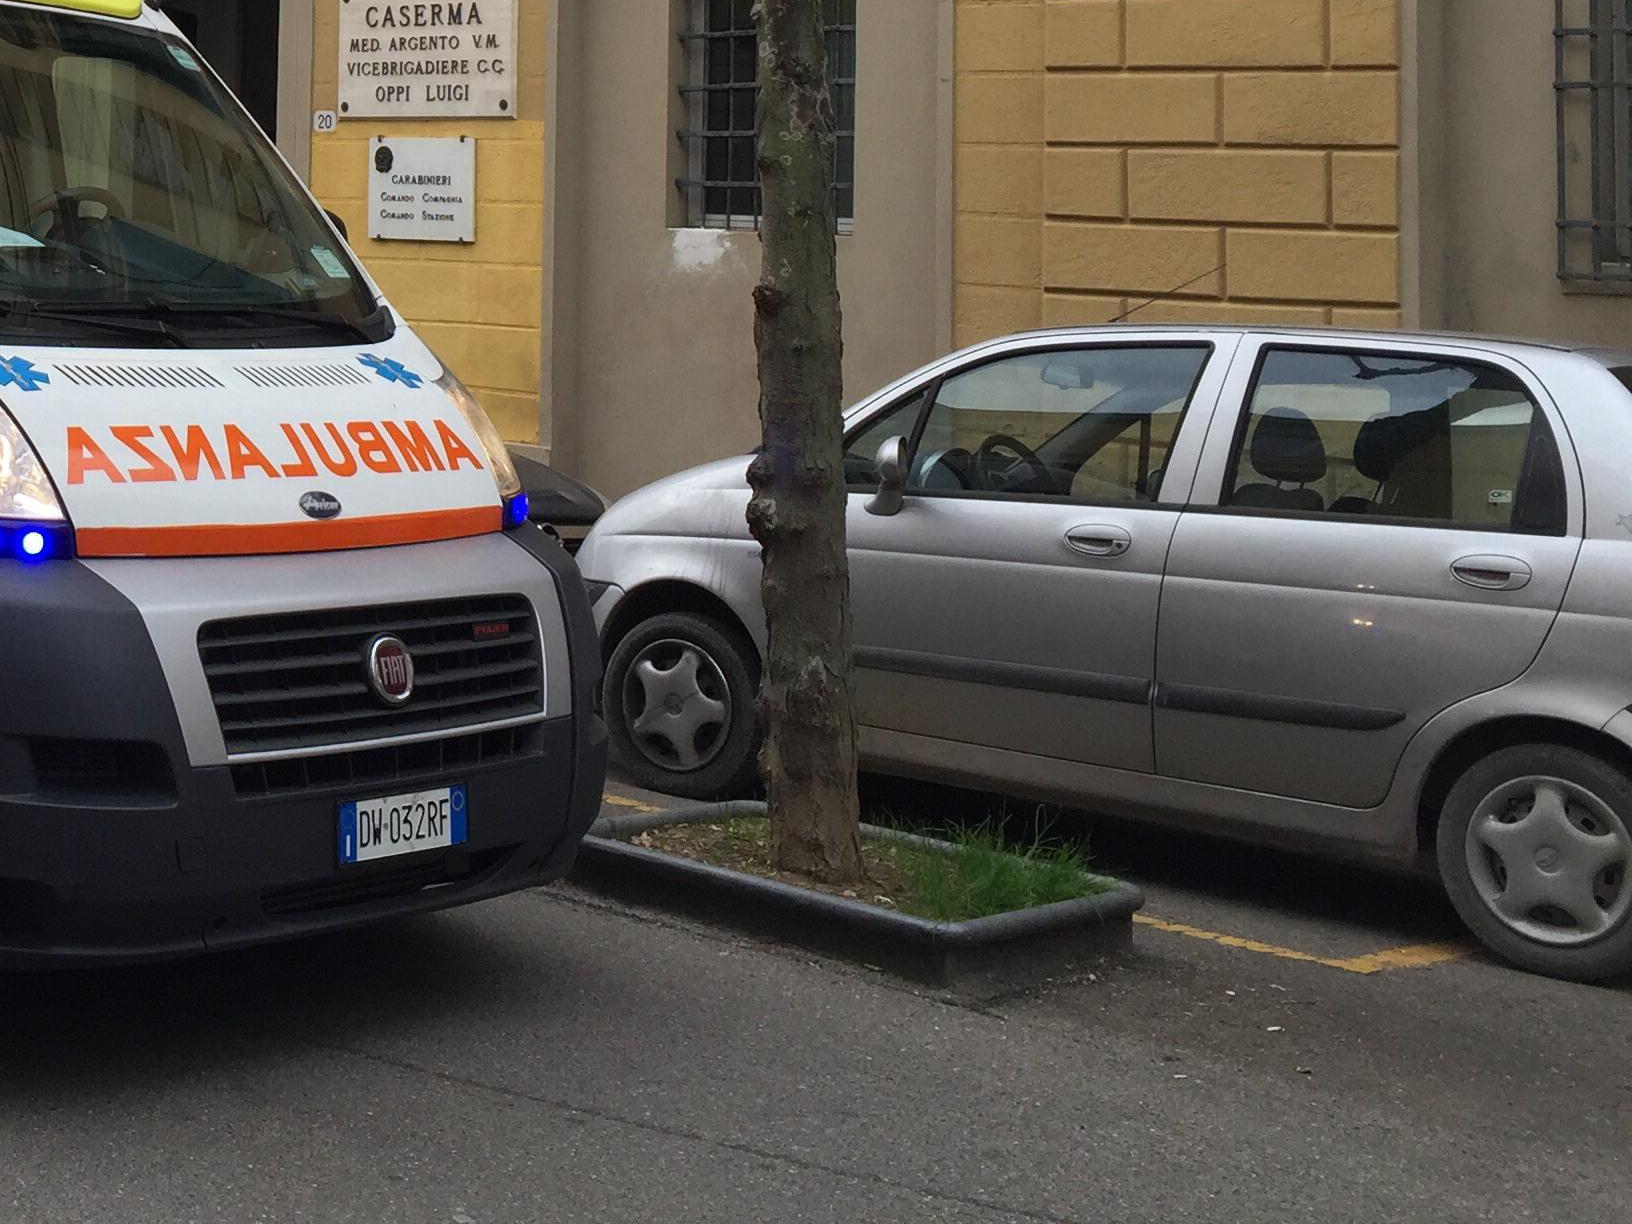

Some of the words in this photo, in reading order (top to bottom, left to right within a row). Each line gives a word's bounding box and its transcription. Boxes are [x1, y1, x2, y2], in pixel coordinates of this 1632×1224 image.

[365, 2, 483, 28] CASERMA
[350, 38, 382, 53] MED.
[389, 35, 460, 52] ARGENTO
[347, 60, 469, 77] VICEBRIGADIERE
[376, 86, 410, 102] OPPI
[426, 84, 469, 101] LUIGI
[318, 114, 332, 129] 20
[391, 174, 452, 186] CARABINIERI
[380, 654, 406, 685] FIAT
